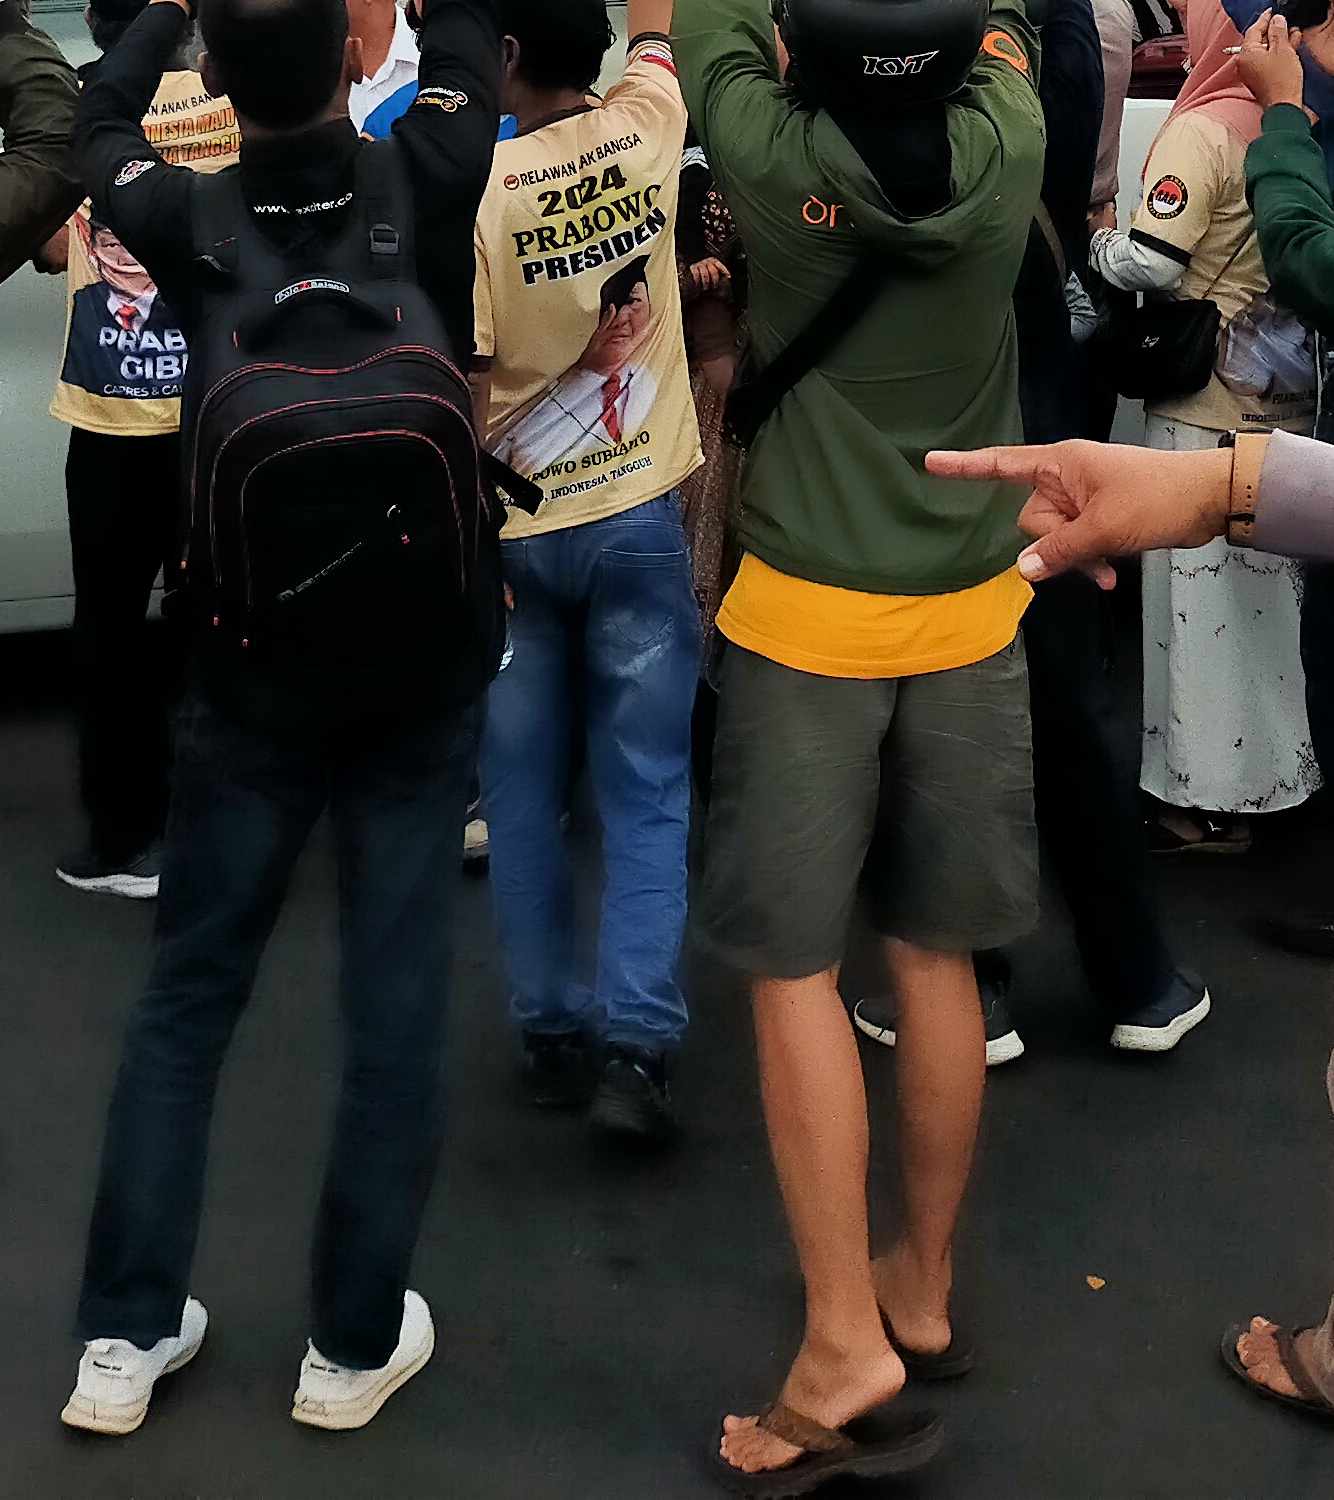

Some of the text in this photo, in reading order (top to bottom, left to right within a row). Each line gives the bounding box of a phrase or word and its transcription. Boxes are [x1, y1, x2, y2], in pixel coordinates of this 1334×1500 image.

[863, 50, 940, 75] KYT
[161, 99, 190, 114] ANAK
[196, 107, 235, 134] MAJU
[519, 160, 577, 187] RELAWAN
[596, 133, 643, 161] BANGSA
[537, 163, 628, 219] 2024
[511, 184, 662, 258] PRABOWO
[521, 206, 667, 286] PRESIDEN
[550, 455, 652, 500] INDONESIA TANGGUH
